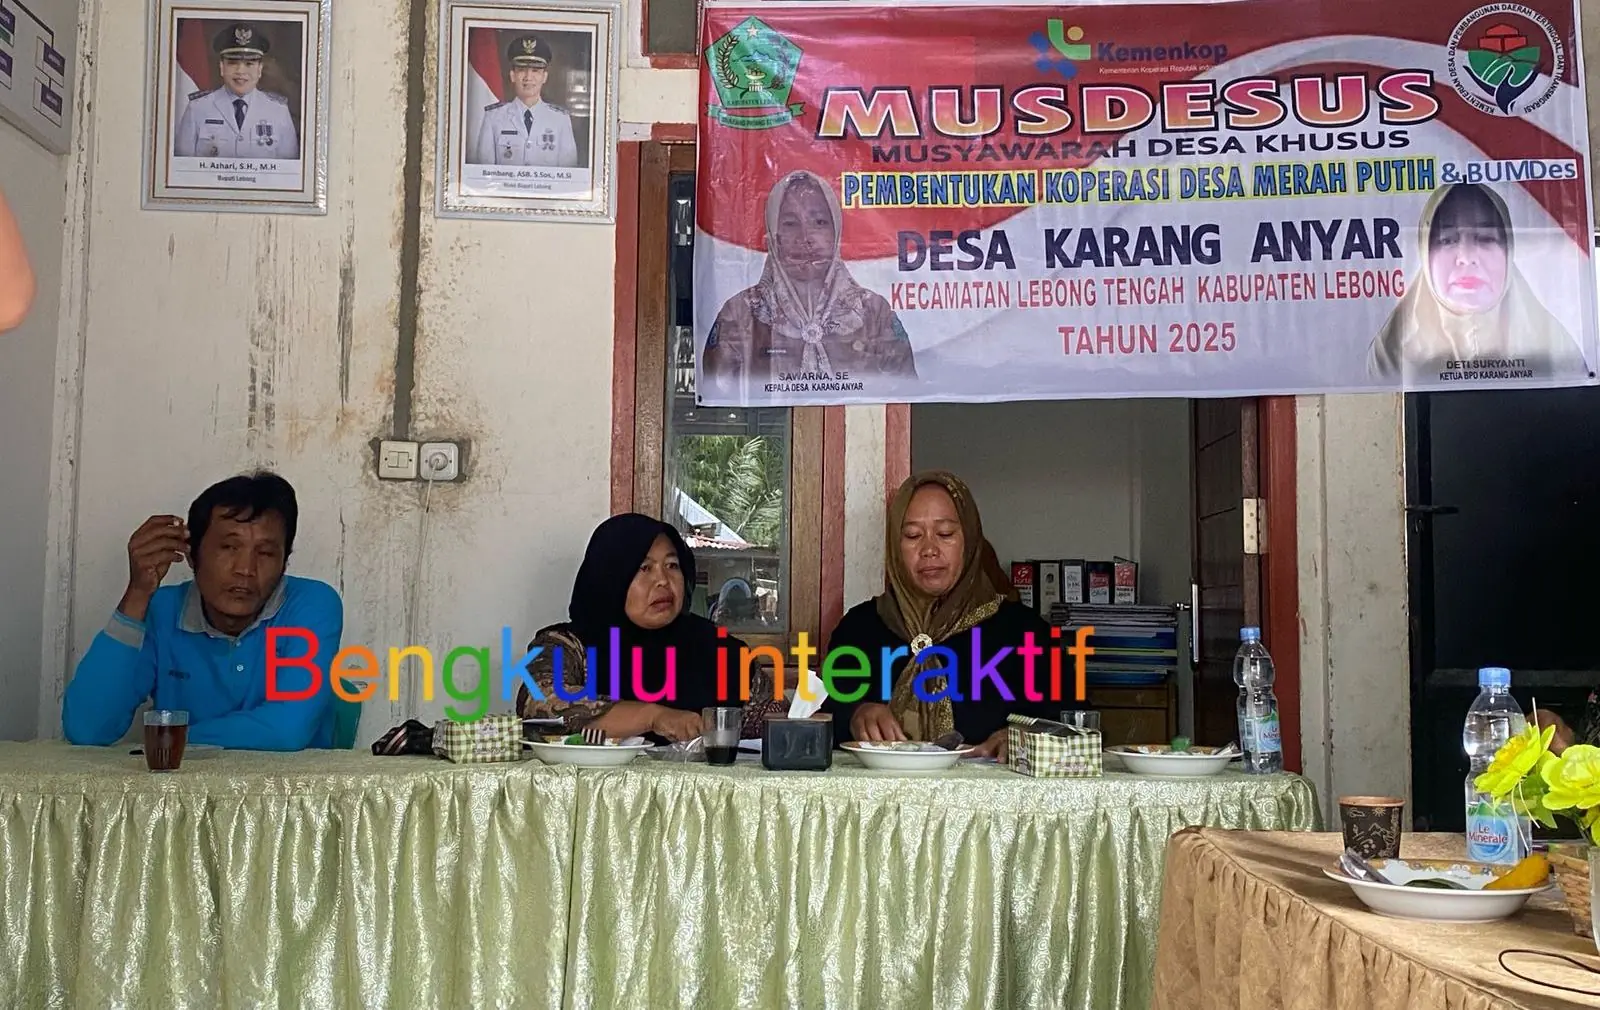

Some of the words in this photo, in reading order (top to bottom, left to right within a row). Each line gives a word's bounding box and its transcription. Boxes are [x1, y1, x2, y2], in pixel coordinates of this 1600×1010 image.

[1501, 3, 1532, 16] DAERAH
[1453, 5, 1500, 39] PEMBANGUNAN
[1098, 41, 1228, 64] Kemenkop
[1448, 41, 1457, 56] DAN
[1170, 64, 1197, 72] Republik
[1448, 58, 1457, 77] DESA
[1556, 54, 1564, 70] DAN
[1523, 72, 1562, 113] TRANSMIGRASI
[816, 69, 1442, 139] MUSDESUS
[872, 139, 1136, 164] MUSYAWARAH
[1148, 136, 1246, 158] DESA
[1256, 130, 1410, 153] KHUSUS
[842, 171, 1036, 206] PEMBENTUKAN
[1045, 167, 1170, 204] KOPERASI
[1179, 165, 1246, 200] DESA
[1253, 162, 1347, 198] MERAH
[1356, 158, 1436, 193] PUTIH
[1441, 162, 1462, 183] &
[1467, 160, 1576, 183] BUMDes
[897, 228, 1016, 272] DESA
[1044, 223, 1221, 269] KARANG
[1250, 217, 1403, 263] ANYAR
[891, 281, 1010, 309] KECAMATAN
[1018, 278, 1096, 308] LEBONG
[1103, 276, 1184, 305] TENGAH
[1197, 272, 1316, 303] KABUPATEN
[1324, 269, 1405, 299] LEBONG
[1058, 324, 1157, 355] TAHUN
[1168, 322, 1236, 352] 2025
[1446, 360, 1470, 369] DETI
[1473, 359, 1525, 368] SURYANTI
[780, 372, 832, 381] SAWARNA,
[835, 371, 849, 380] SE
[1440, 372, 1463, 380] KETUA
[1480, 370, 1508, 379] KARANG
[1510, 369, 1533, 378] ANYAR
[764, 383, 790, 392] KEPALA
[791, 383, 809, 392] DESA
[812, 382, 840, 392] KARANG
[841, 382, 863, 391] ANYAR
[1478, 823, 1490, 834] Le
[1468, 832, 1508, 844] Minerale
